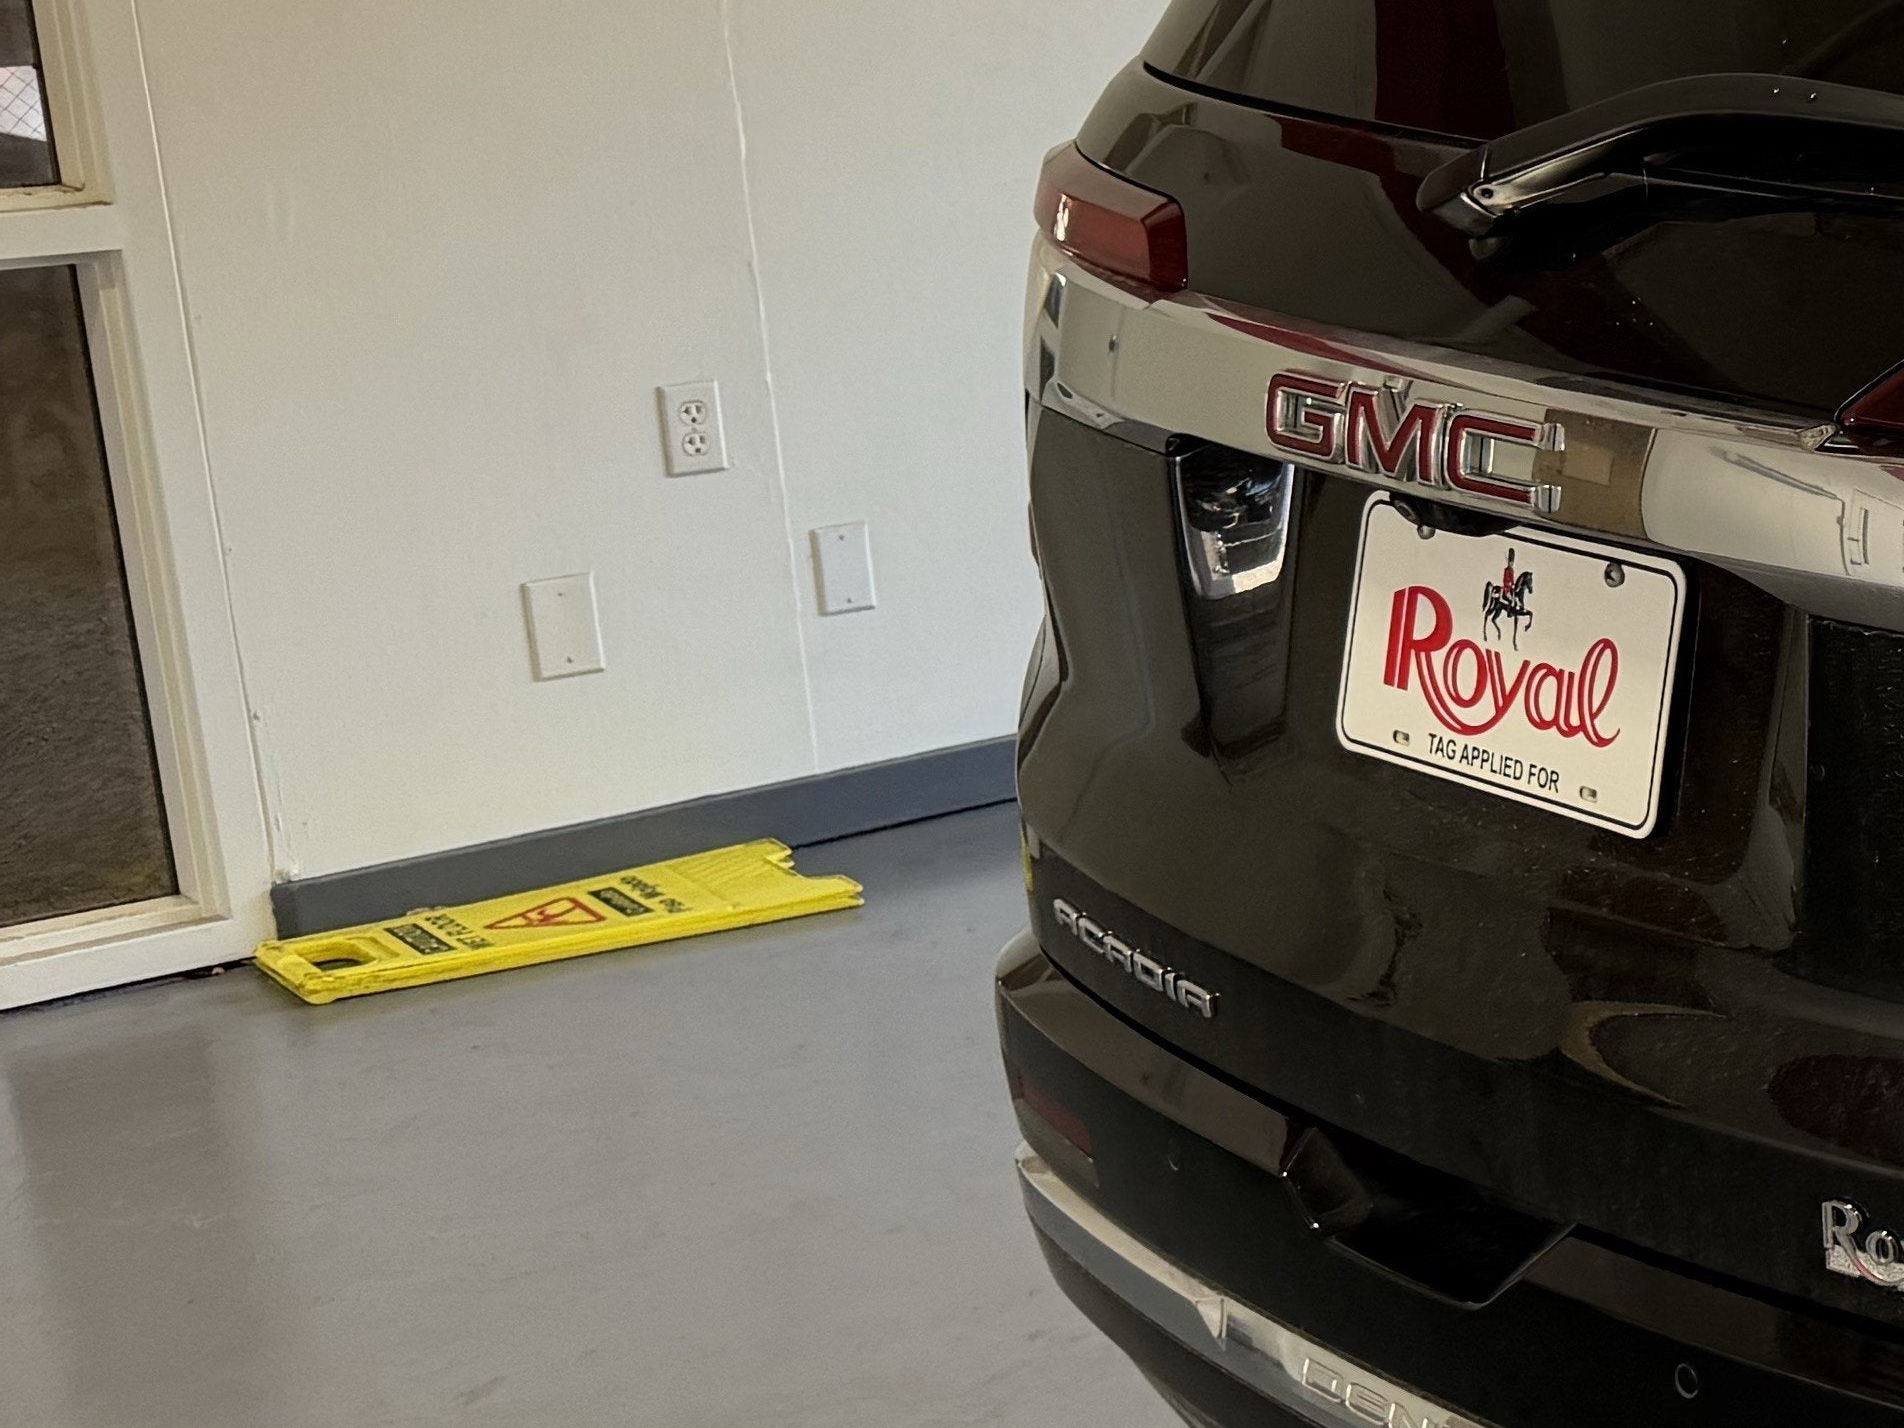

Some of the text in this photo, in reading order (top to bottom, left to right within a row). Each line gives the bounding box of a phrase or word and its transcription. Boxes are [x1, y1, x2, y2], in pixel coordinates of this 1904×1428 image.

[1265, 372, 1564, 512] GMC
[1382, 585, 1621, 748] Royal
[1427, 732, 1560, 794] TAG APPLIED FOR
[1053, 897, 1215, 1019] ACADIA
